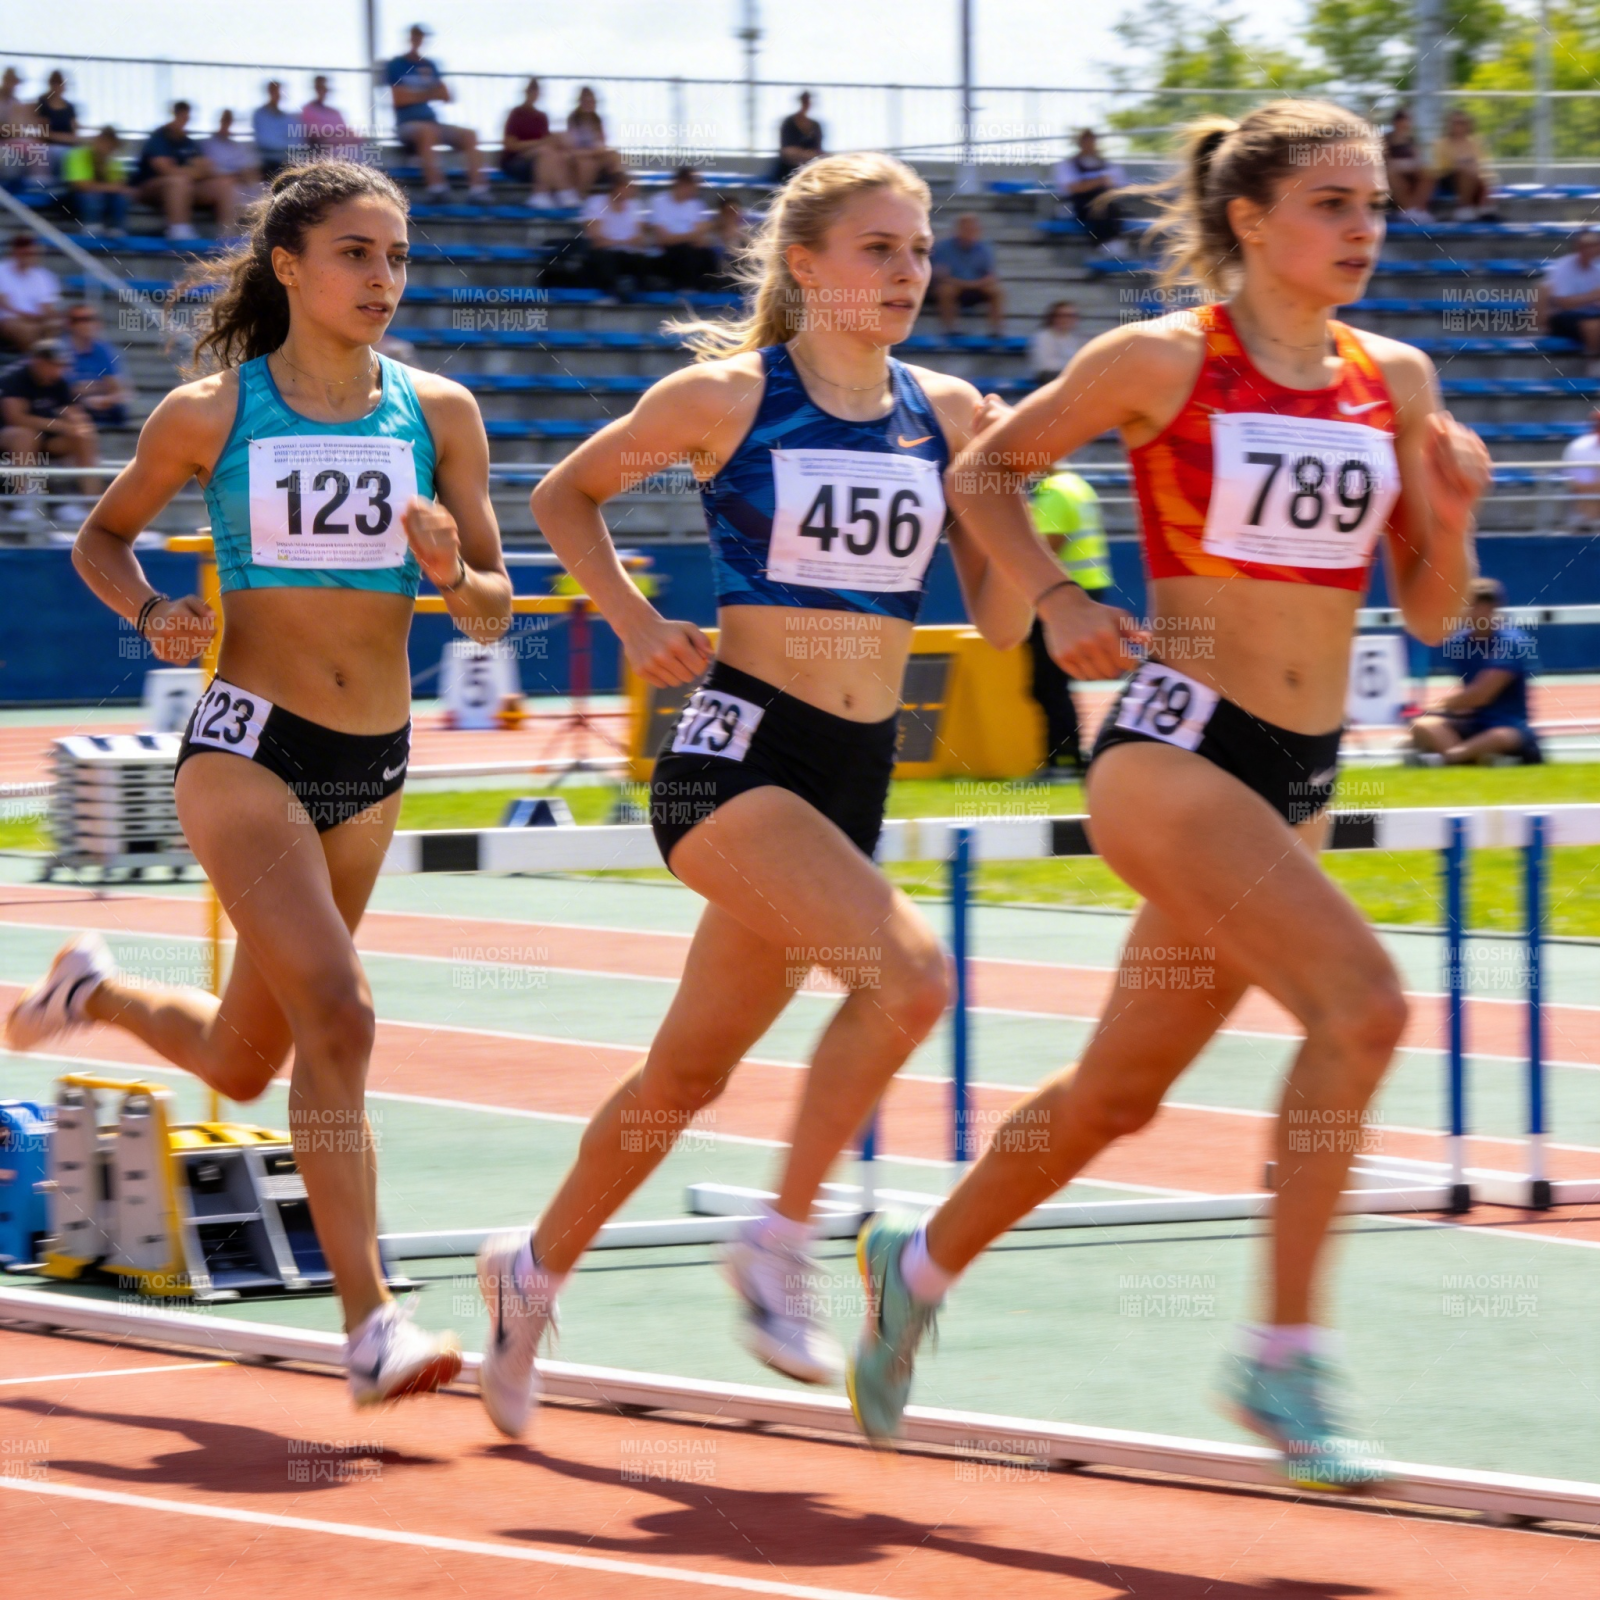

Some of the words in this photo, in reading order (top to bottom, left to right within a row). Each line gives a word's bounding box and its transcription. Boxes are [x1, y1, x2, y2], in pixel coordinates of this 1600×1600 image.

[275, 469, 393, 536] 123
[797, 484, 922, 558] 456
[1244, 451, 1372, 533] 789
[196, 691, 255, 744] 123
